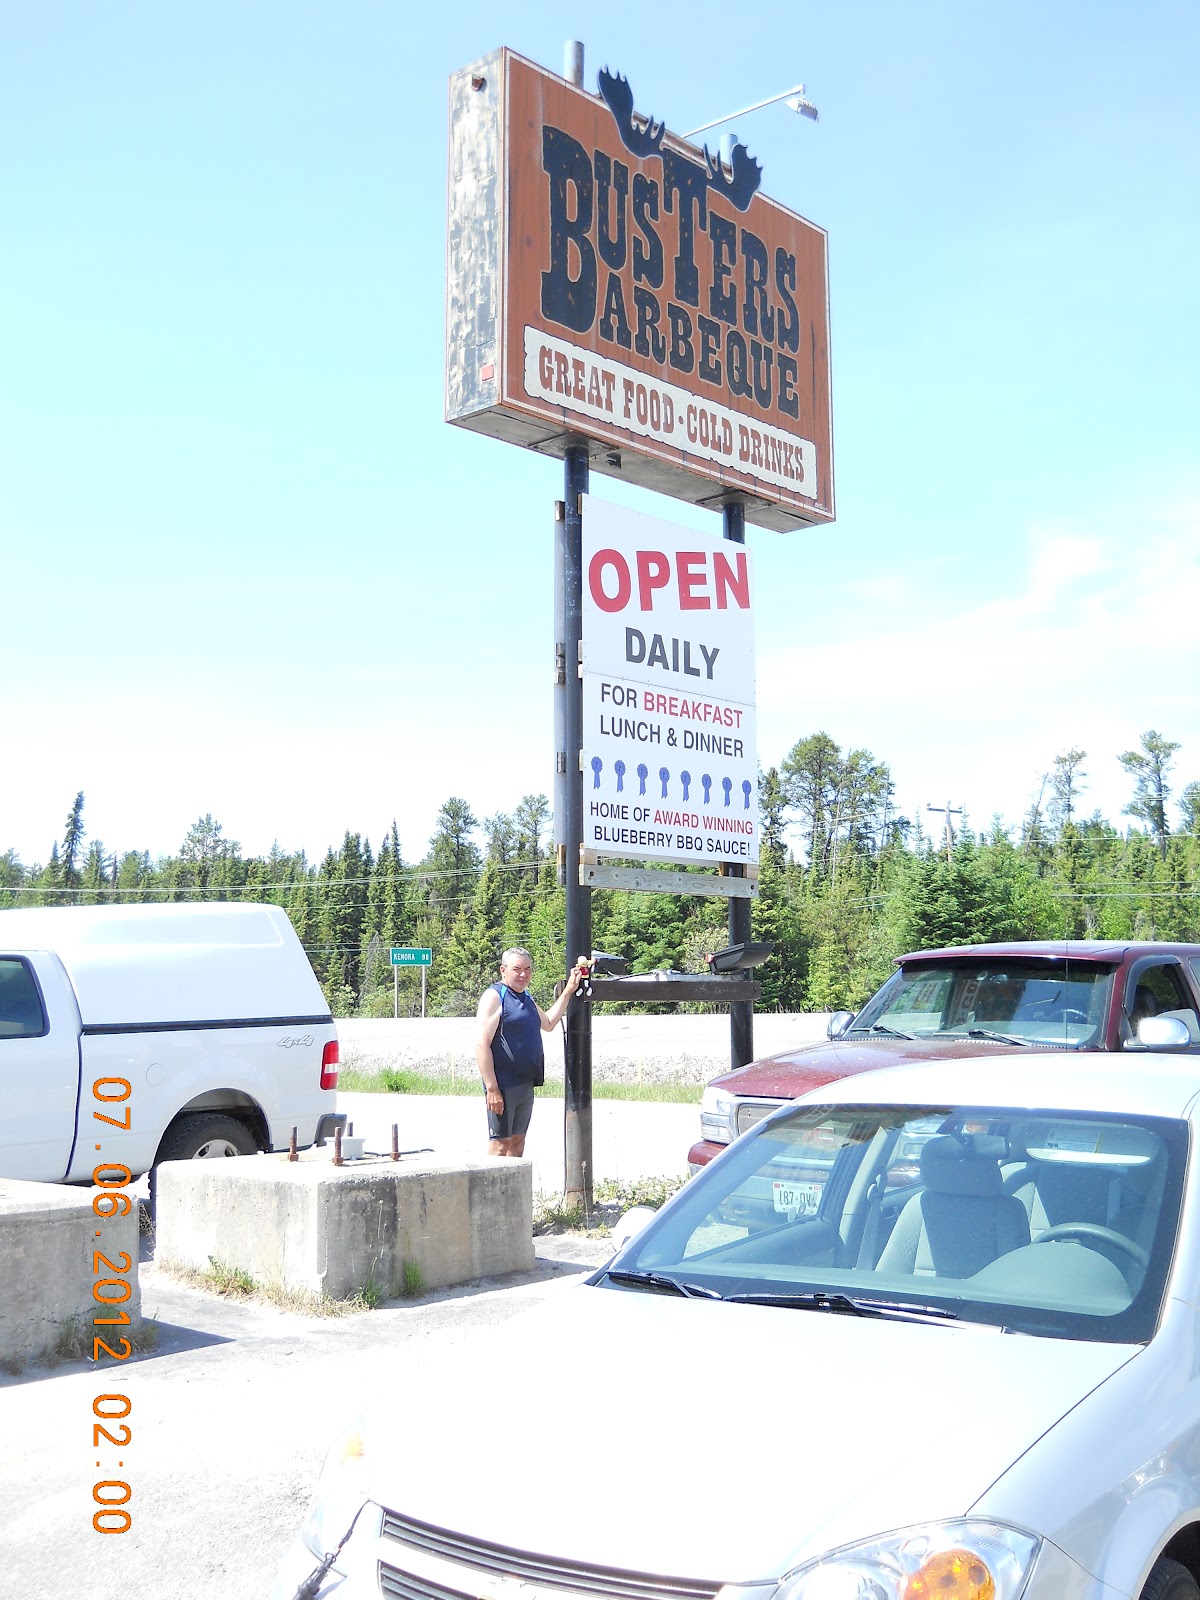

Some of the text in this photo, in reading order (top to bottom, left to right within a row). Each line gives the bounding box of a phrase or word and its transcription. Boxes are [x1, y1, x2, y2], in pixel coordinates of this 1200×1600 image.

[541, 125, 800, 354] BUSTERS
[538, 345, 805, 484] GREAT FOOD COLD DRINKS
[588, 548, 750, 613] OPEN
[625, 626, 720, 680] DAILY
[601, 682, 743, 728] FOR BREAKFAST
[600, 714, 744, 758] LUNCH & DINNER
[590, 801, 753, 835] HOME OF AWARD WINNING
[594, 825, 751, 856] BLUEBERRY BBQ SAUCE!
[393, 953, 415, 961] KENORA
[277, 1034, 315, 1048] 4x4
